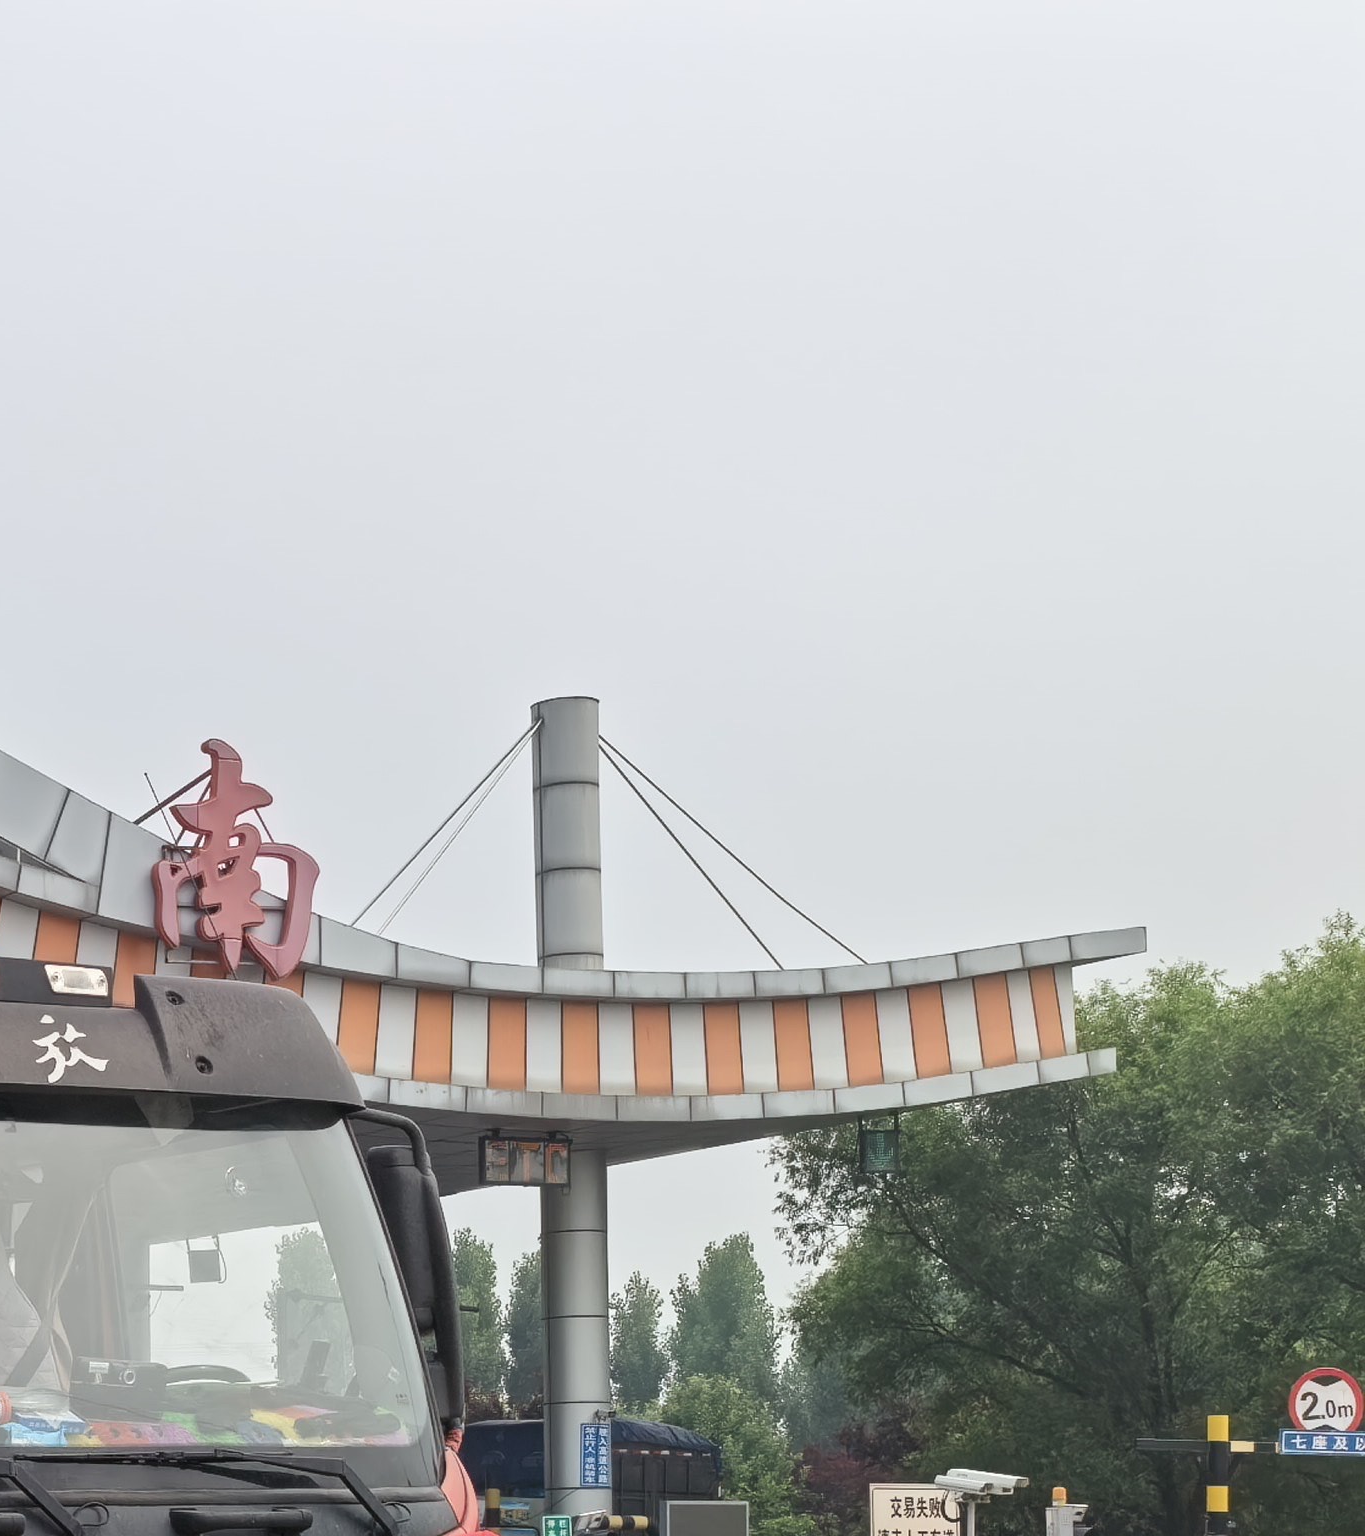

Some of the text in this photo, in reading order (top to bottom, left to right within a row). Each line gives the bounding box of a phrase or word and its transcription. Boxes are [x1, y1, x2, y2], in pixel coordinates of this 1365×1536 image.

[151, 738, 320, 980] 南
[1300, 1391, 1354, 1421] 2.0m
[889, 1496, 942, 1519] 交易失败
